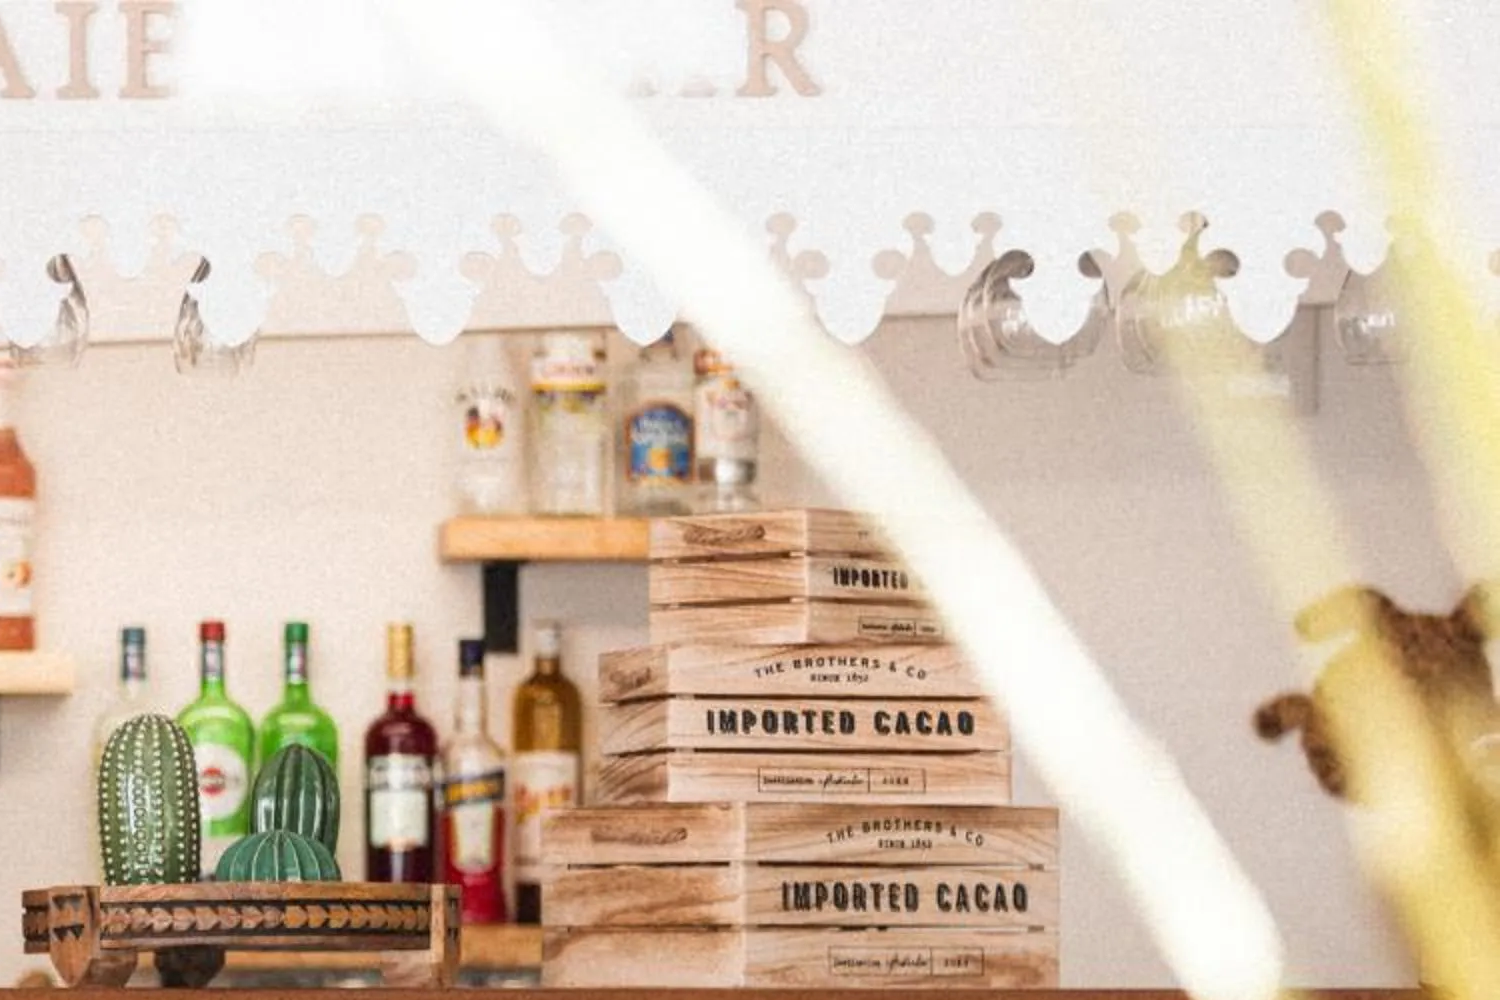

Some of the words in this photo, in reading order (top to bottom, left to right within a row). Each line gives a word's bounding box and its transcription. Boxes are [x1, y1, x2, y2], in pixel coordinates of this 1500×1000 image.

[754, 661, 786, 679] THE
[793, 655, 881, 669] BROTHERS
[888, 660, 897, 673] &
[706, 708, 856, 736] IMPORTED
[873, 709, 975, 736] CACAO
[826, 824, 854, 844] THE
[861, 817, 942, 833] BROTHERS
[781, 880, 920, 912] IMPORTED
[936, 881, 1029, 913] CACAO
